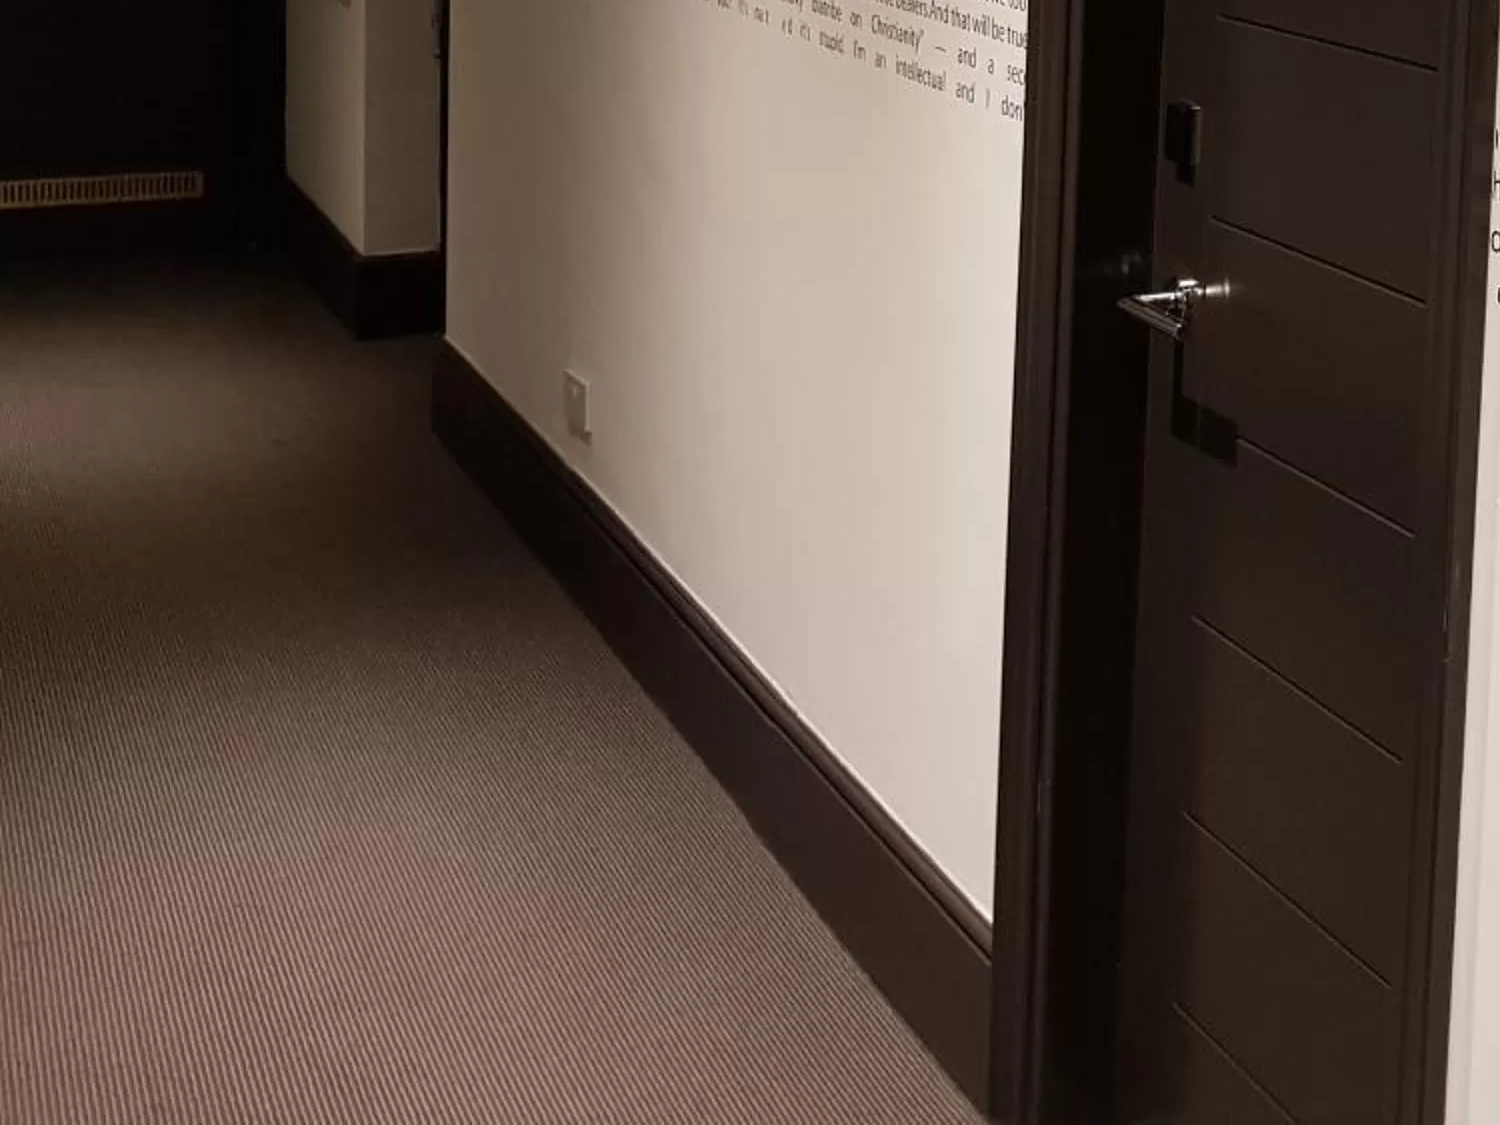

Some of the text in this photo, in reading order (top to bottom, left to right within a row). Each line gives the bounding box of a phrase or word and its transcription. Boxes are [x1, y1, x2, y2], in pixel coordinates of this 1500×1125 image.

[951, 4, 971, 31] that
[956, 44, 994, 74] and a
[955, 79, 974, 103] and
